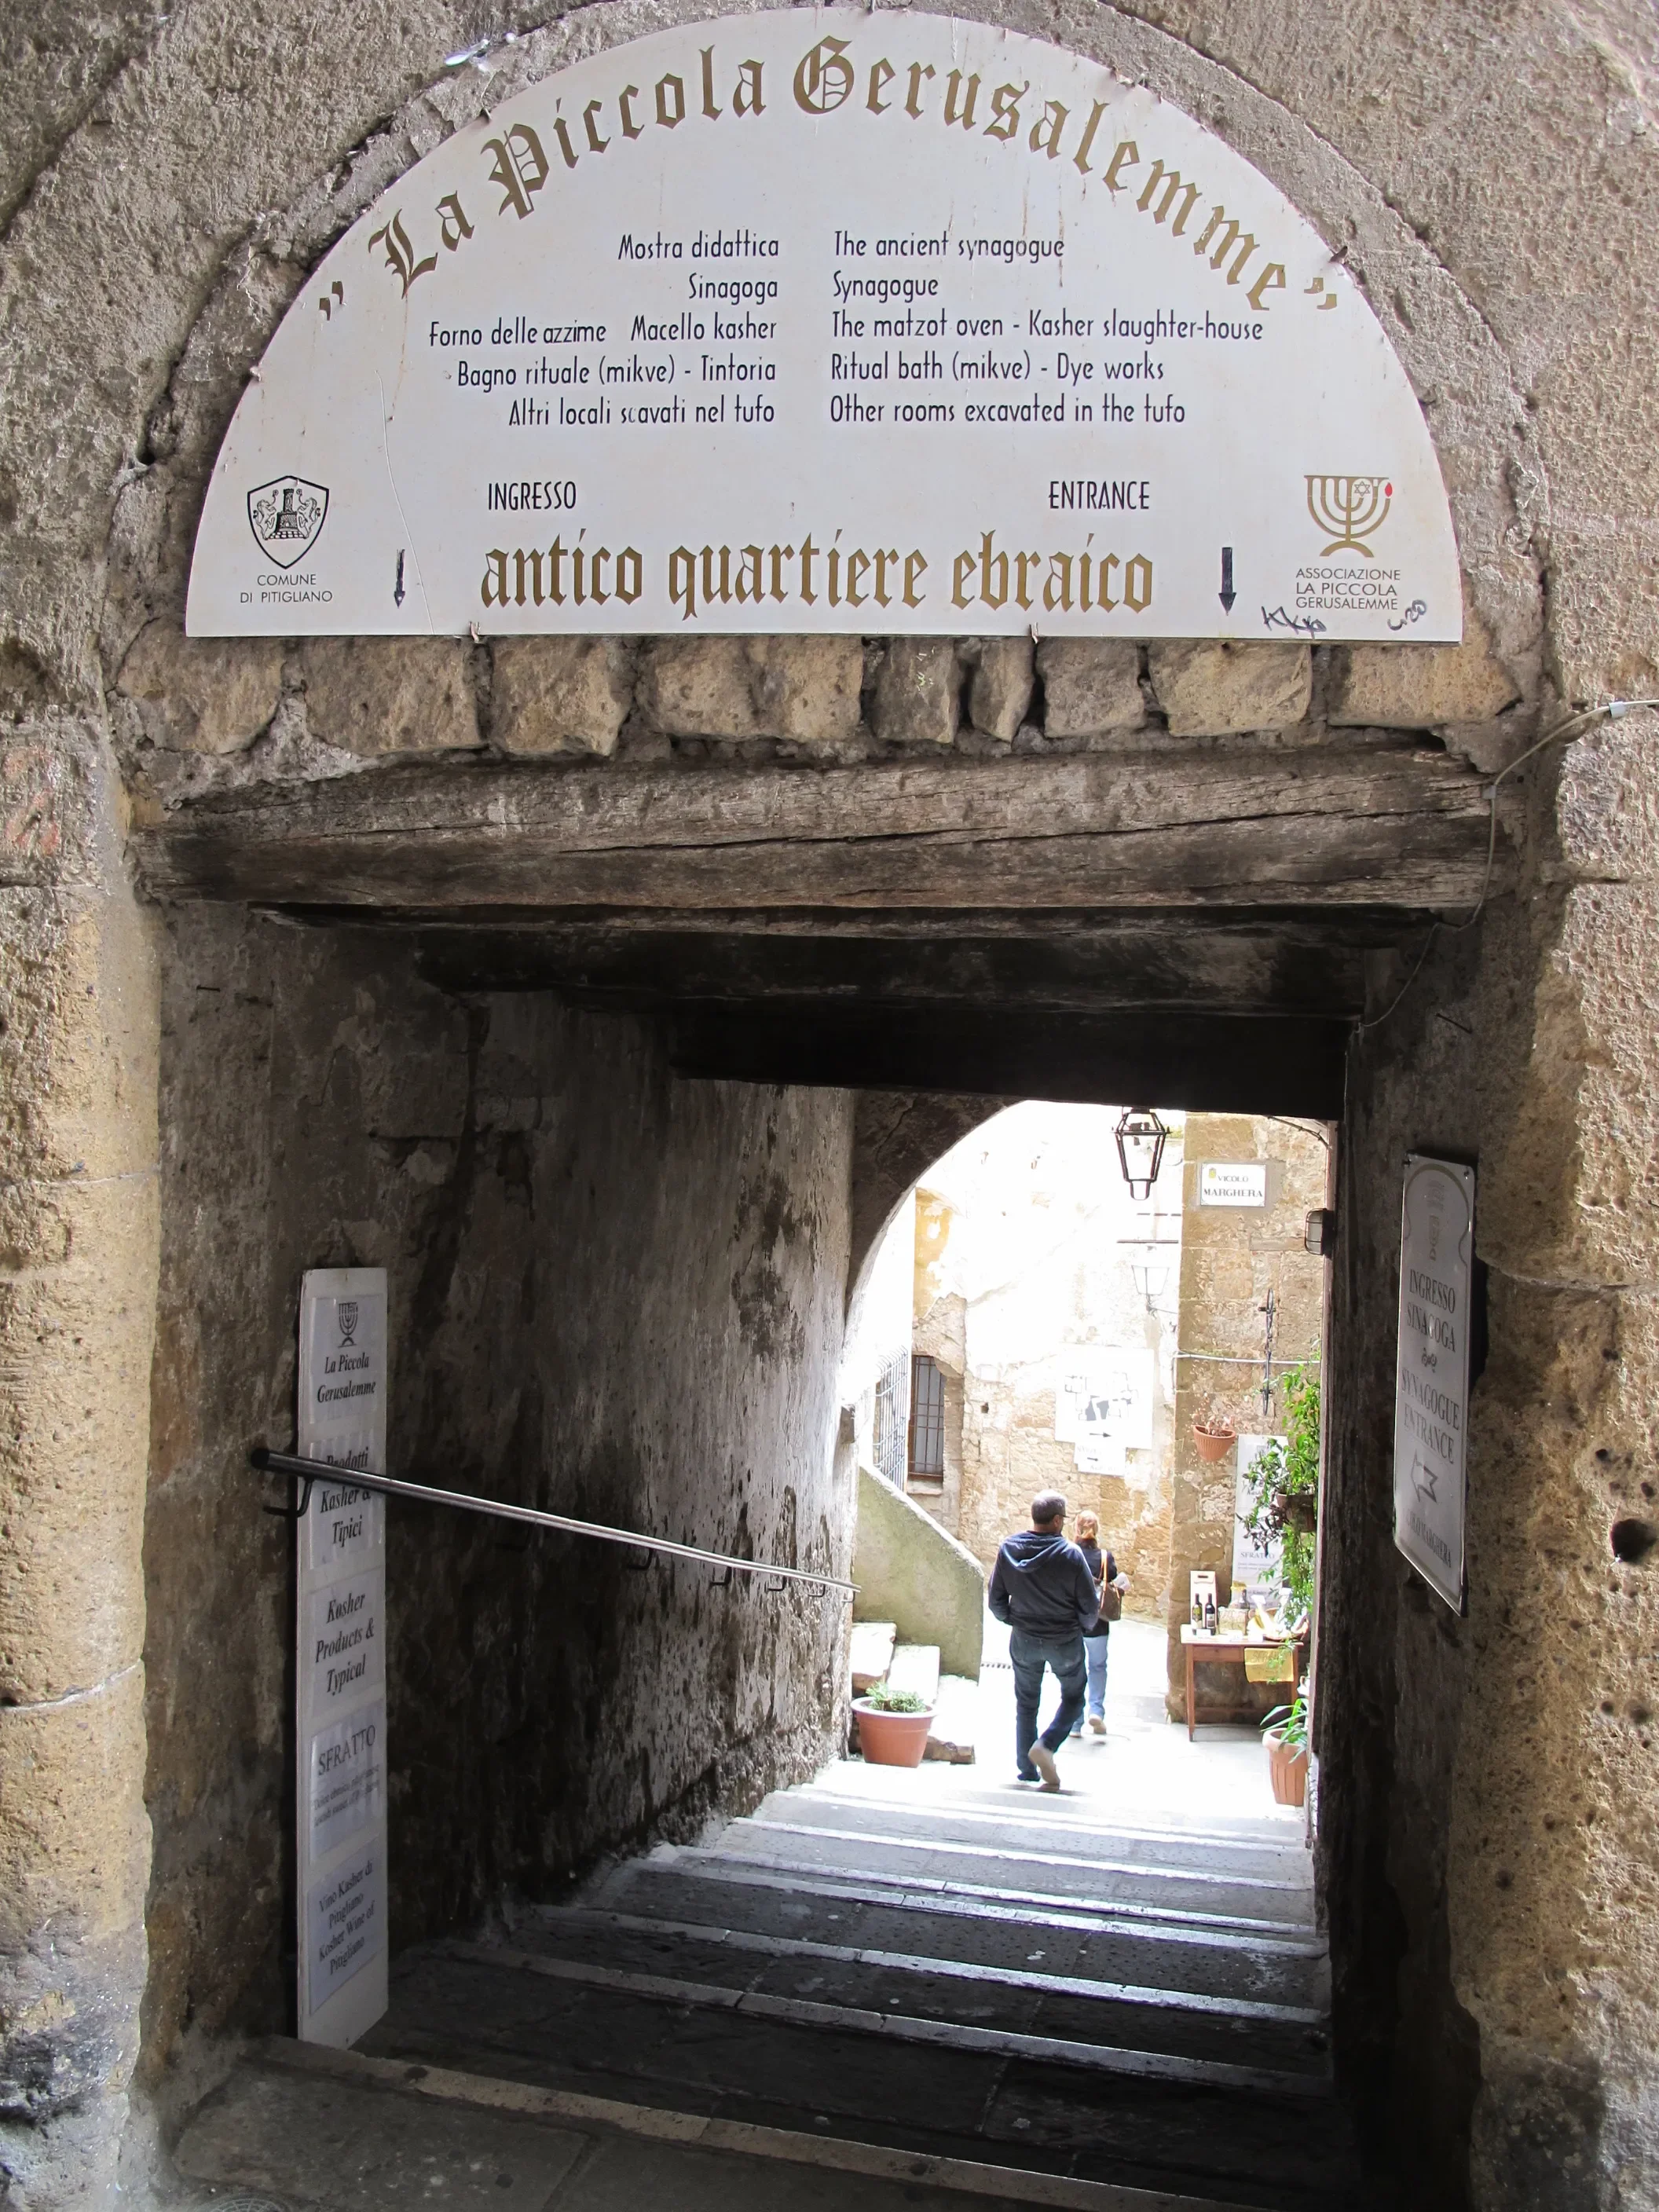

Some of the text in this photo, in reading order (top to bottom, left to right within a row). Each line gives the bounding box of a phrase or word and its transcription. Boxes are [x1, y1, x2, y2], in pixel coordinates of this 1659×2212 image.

[481, 46, 767, 220] Piccola
[618, 229, 779, 261] Mostra didattica
[834, 231, 1064, 264] The ancient synagogue
[688, 273, 778, 306] Sinagoga
[833, 272, 939, 304] Synagogue
[430, 311, 777, 346] Forno delle azzime Macello kasher
[833, 309, 865, 338] The
[874, 308, 947, 337] matzot
[957, 319, 1002, 337] oven
[1029, 307, 1094, 337] Kasher
[1103, 308, 1264, 346] slaughter-house
[458, 361, 517, 393] Bagno
[526, 357, 590, 385] rituale
[599, 355, 676, 385] (mikve)
[701, 352, 776, 382] Tintoria
[832, 351, 888, 380] Ritual
[899, 350, 942, 379] bath
[952, 350, 1031, 382] (mikve)
[1057, 353, 1093, 386] Dye
[1104, 350, 1164, 380] works
[509, 394, 775, 427] Altri locali scavati nel tufo
[830, 393, 1185, 423] Other rooms excavated in the tufo
[488, 481, 577, 511] INGRESSO
[1048, 480, 1150, 511] ENTRANCE
[257, 573, 317, 587] COMUNE
[480, 529, 1153, 621] antico quartiere ebraico
[1295, 567, 1401, 580] ASSOCIAZIONE
[1296, 582, 1397, 596] LA PICCOLA
[240, 591, 333, 603] DI PITIGLIANO
[1295, 596, 1398, 610] GERUSALEMME
[1203, 1188, 1263, 1198] MARGHERA
[1408, 1269, 1456, 1315] INGRESSO
[1406, 1302, 1456, 1353] SINAGOGA
[324, 1351, 370, 1374] La Piccola
[317, 1379, 377, 1404] Gerusalemme
[1401, 1368, 1459, 1430] SYNAGOGUE
[1403, 1403, 1455, 1465] ENTRANCE
[320, 1485, 361, 1513] Kasher
[331, 1515, 363, 1546] Tipici
[325, 1592, 366, 1624] Kosher
[315, 1617, 375, 1664] Products &
[325, 1654, 366, 1697] Typical
[318, 1724, 376, 1776] SFRATTO
[319, 1892, 337, 1913] Vino
[328, 1892, 364, 1930] Pitigliano
[346, 1913, 365, 1936] Wine
[329, 1936, 365, 1976] Pitigliano
